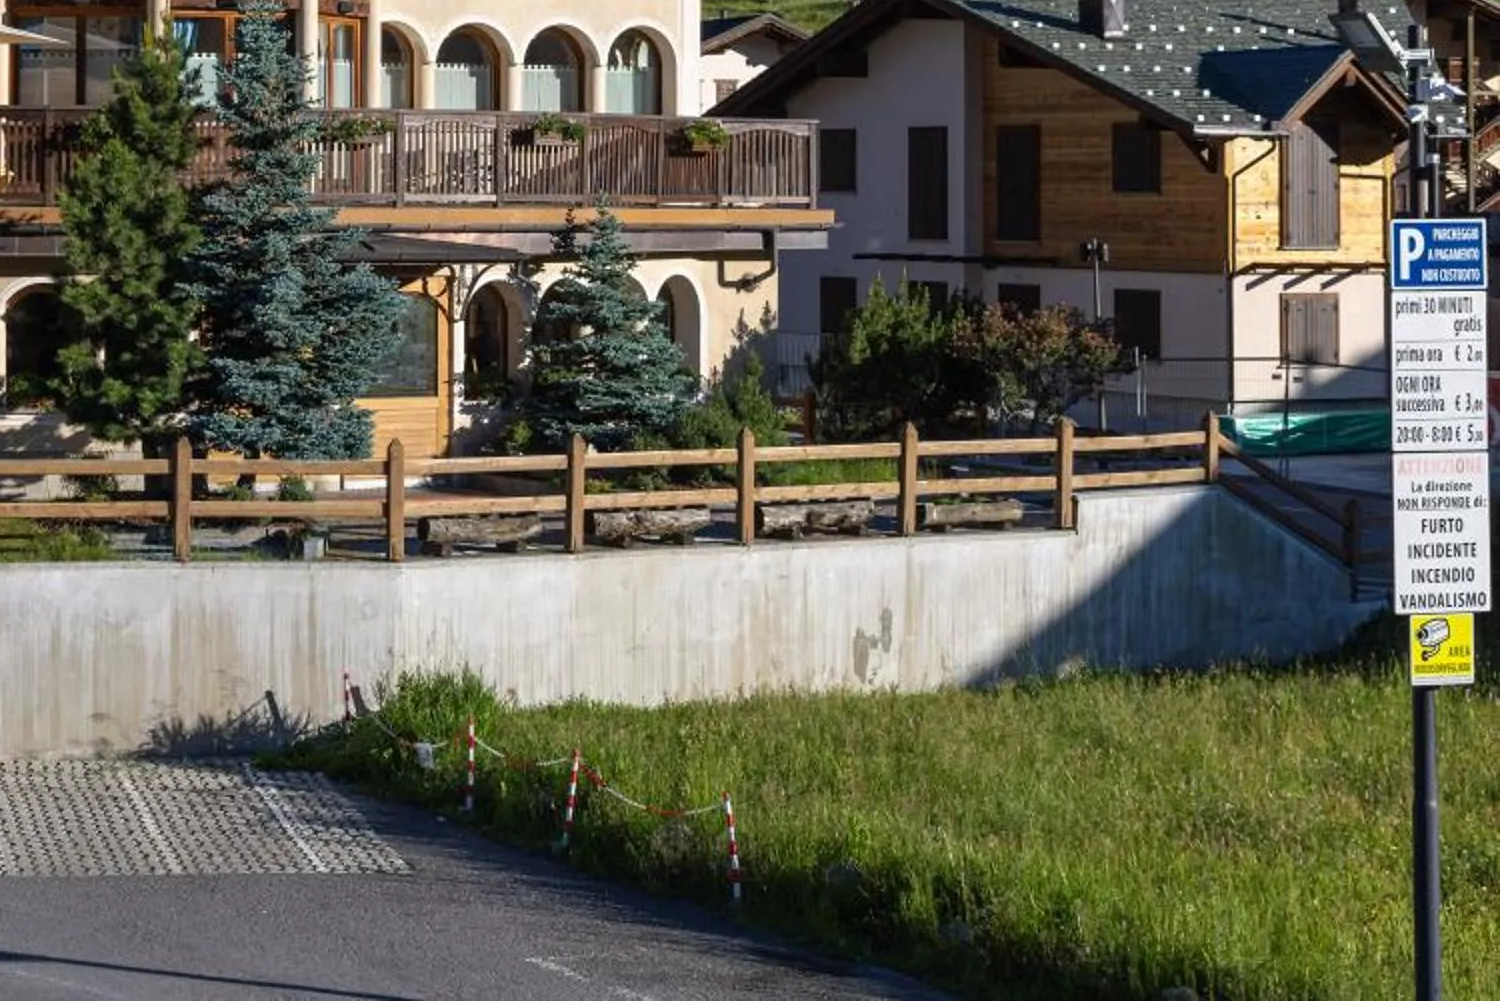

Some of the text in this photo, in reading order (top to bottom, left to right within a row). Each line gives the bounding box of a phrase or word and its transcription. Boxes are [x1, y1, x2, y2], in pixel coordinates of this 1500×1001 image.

[1400, 228, 1425, 280] P
[1396, 297, 1473, 318] primi 30 MINUTI
[1454, 316, 1482, 336] gratis
[1396, 347, 1425, 366] prima
[1427, 349, 1443, 362] ora
[1396, 376, 1442, 393] OGNI ORA
[1396, 395, 1445, 412] successiva
[1398, 458, 1482, 476] ATTENZIONE
[1411, 481, 1473, 493] La direzione
[1398, 499, 1419, 510] NON
[1422, 497, 1471, 509] RISPONDE
[1421, 518, 1464, 534] FURTO
[1407, 542, 1477, 559] INCIDENTE
[1411, 566, 1475, 584] INCENDIO
[1400, 591, 1487, 609] VANDALISMO
